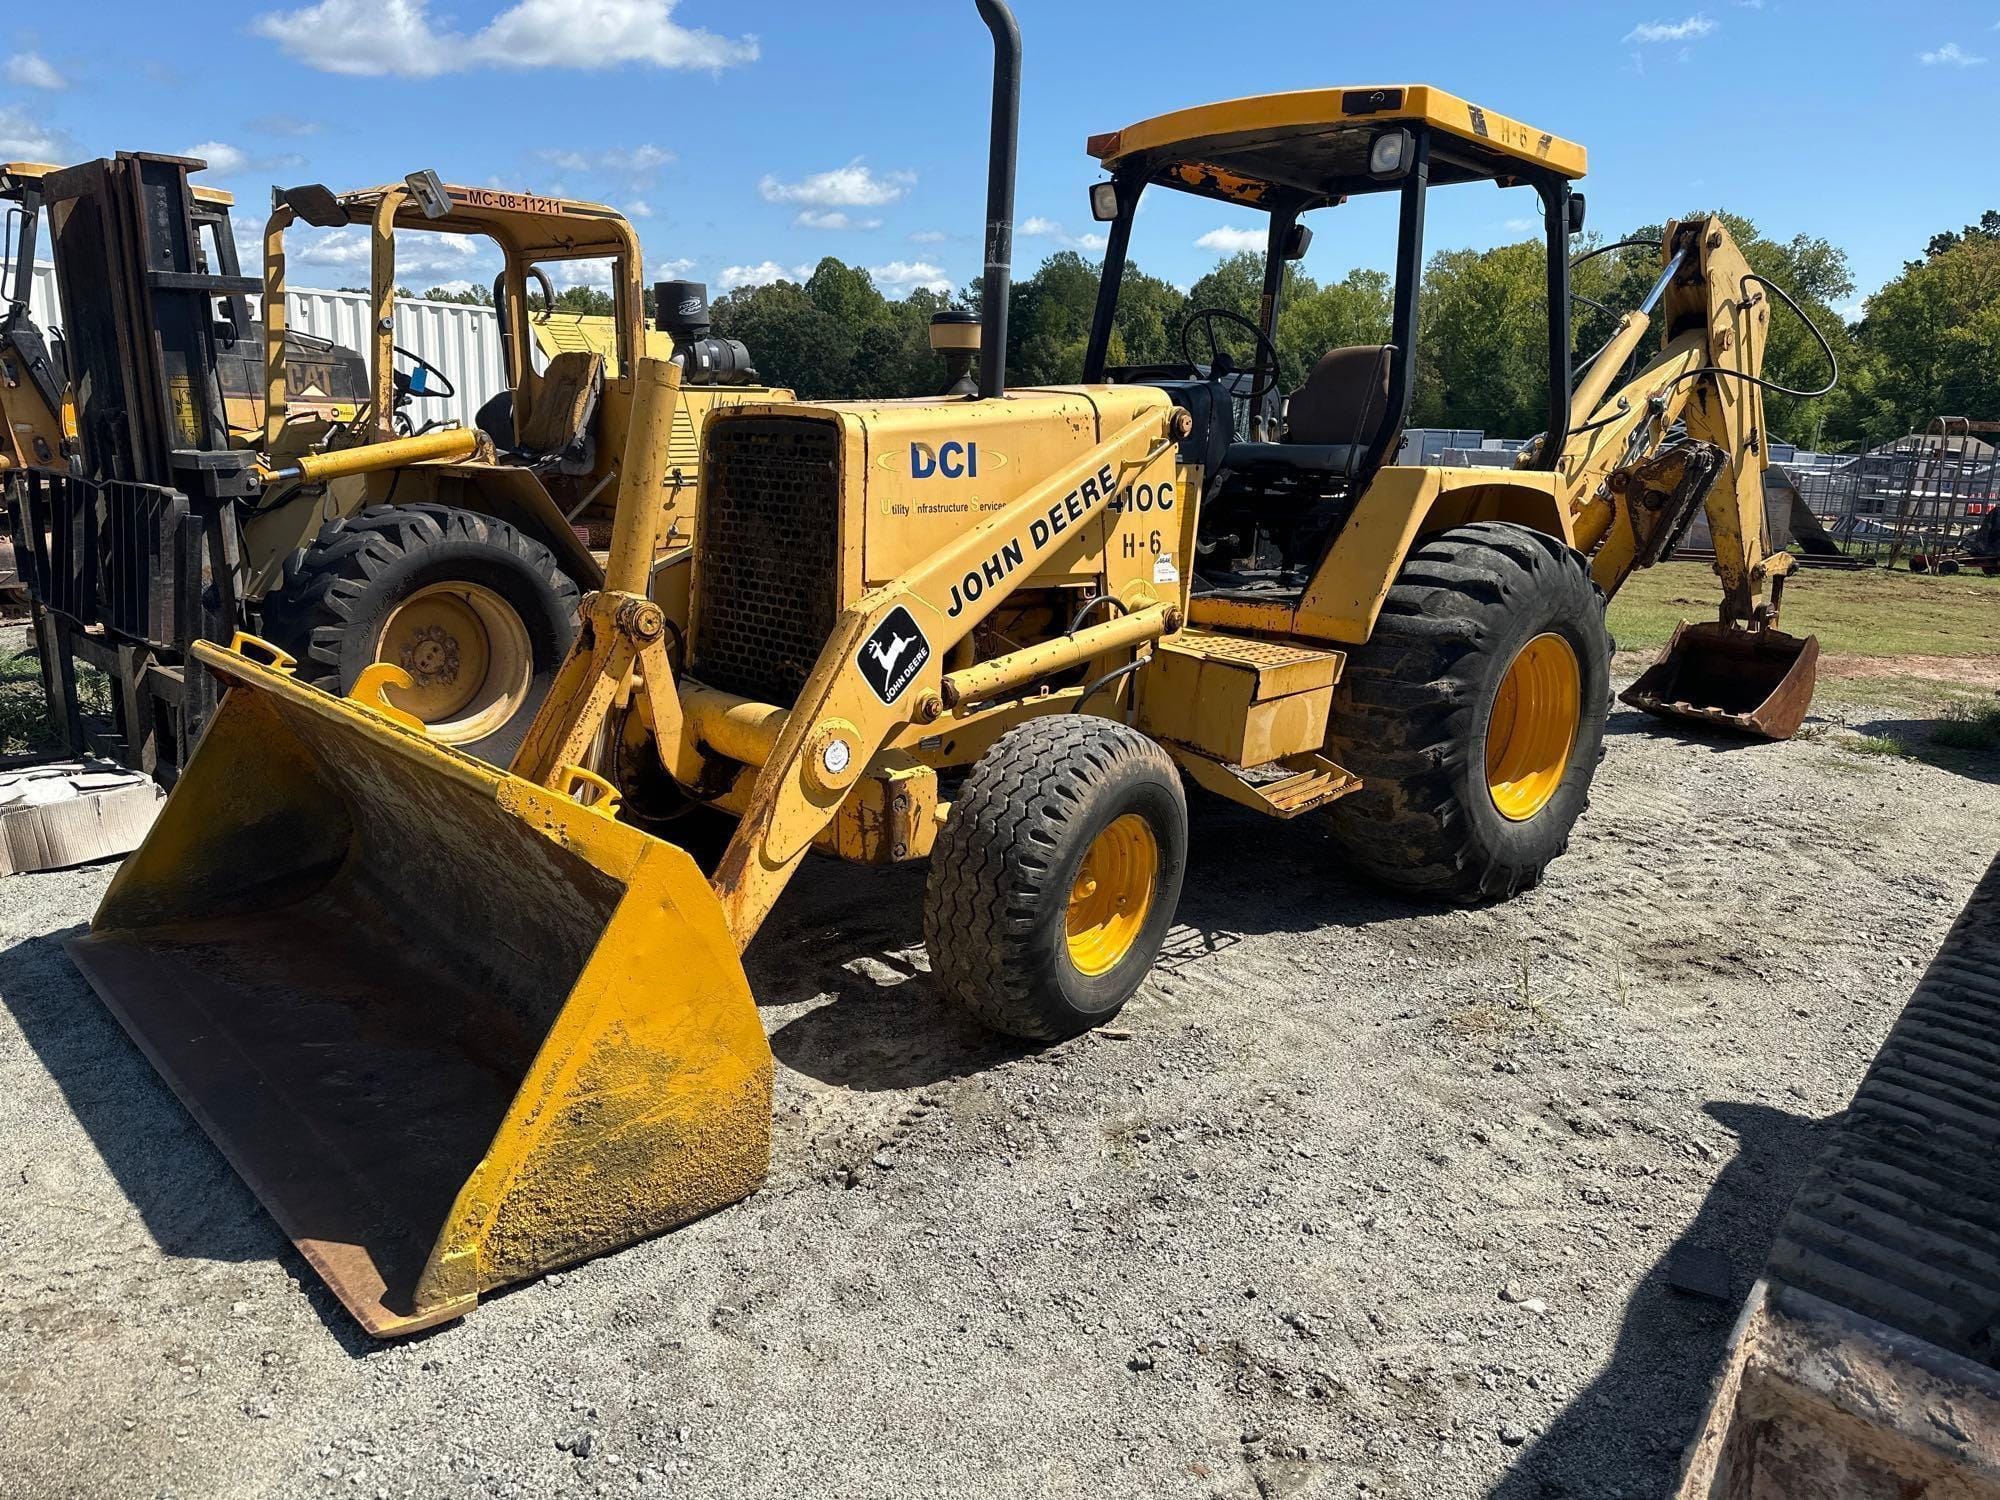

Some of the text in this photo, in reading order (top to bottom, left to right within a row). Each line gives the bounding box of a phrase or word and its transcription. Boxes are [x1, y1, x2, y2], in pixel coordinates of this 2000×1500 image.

[1501, 119, 1528, 149] H-6
[469, 191, 560, 214] MC-08-11211
[286, 363, 332, 397] CAT
[911, 441, 977, 479] DCI
[880, 498, 909, 517] Utility
[912, 498, 969, 515] Infrastructure
[1107, 482, 1174, 514] 410C
[947, 463, 1117, 617] JOHN DEERE
[1123, 529, 1162, 558] H-6
[885, 646, 928, 702] JOHN DEERE
